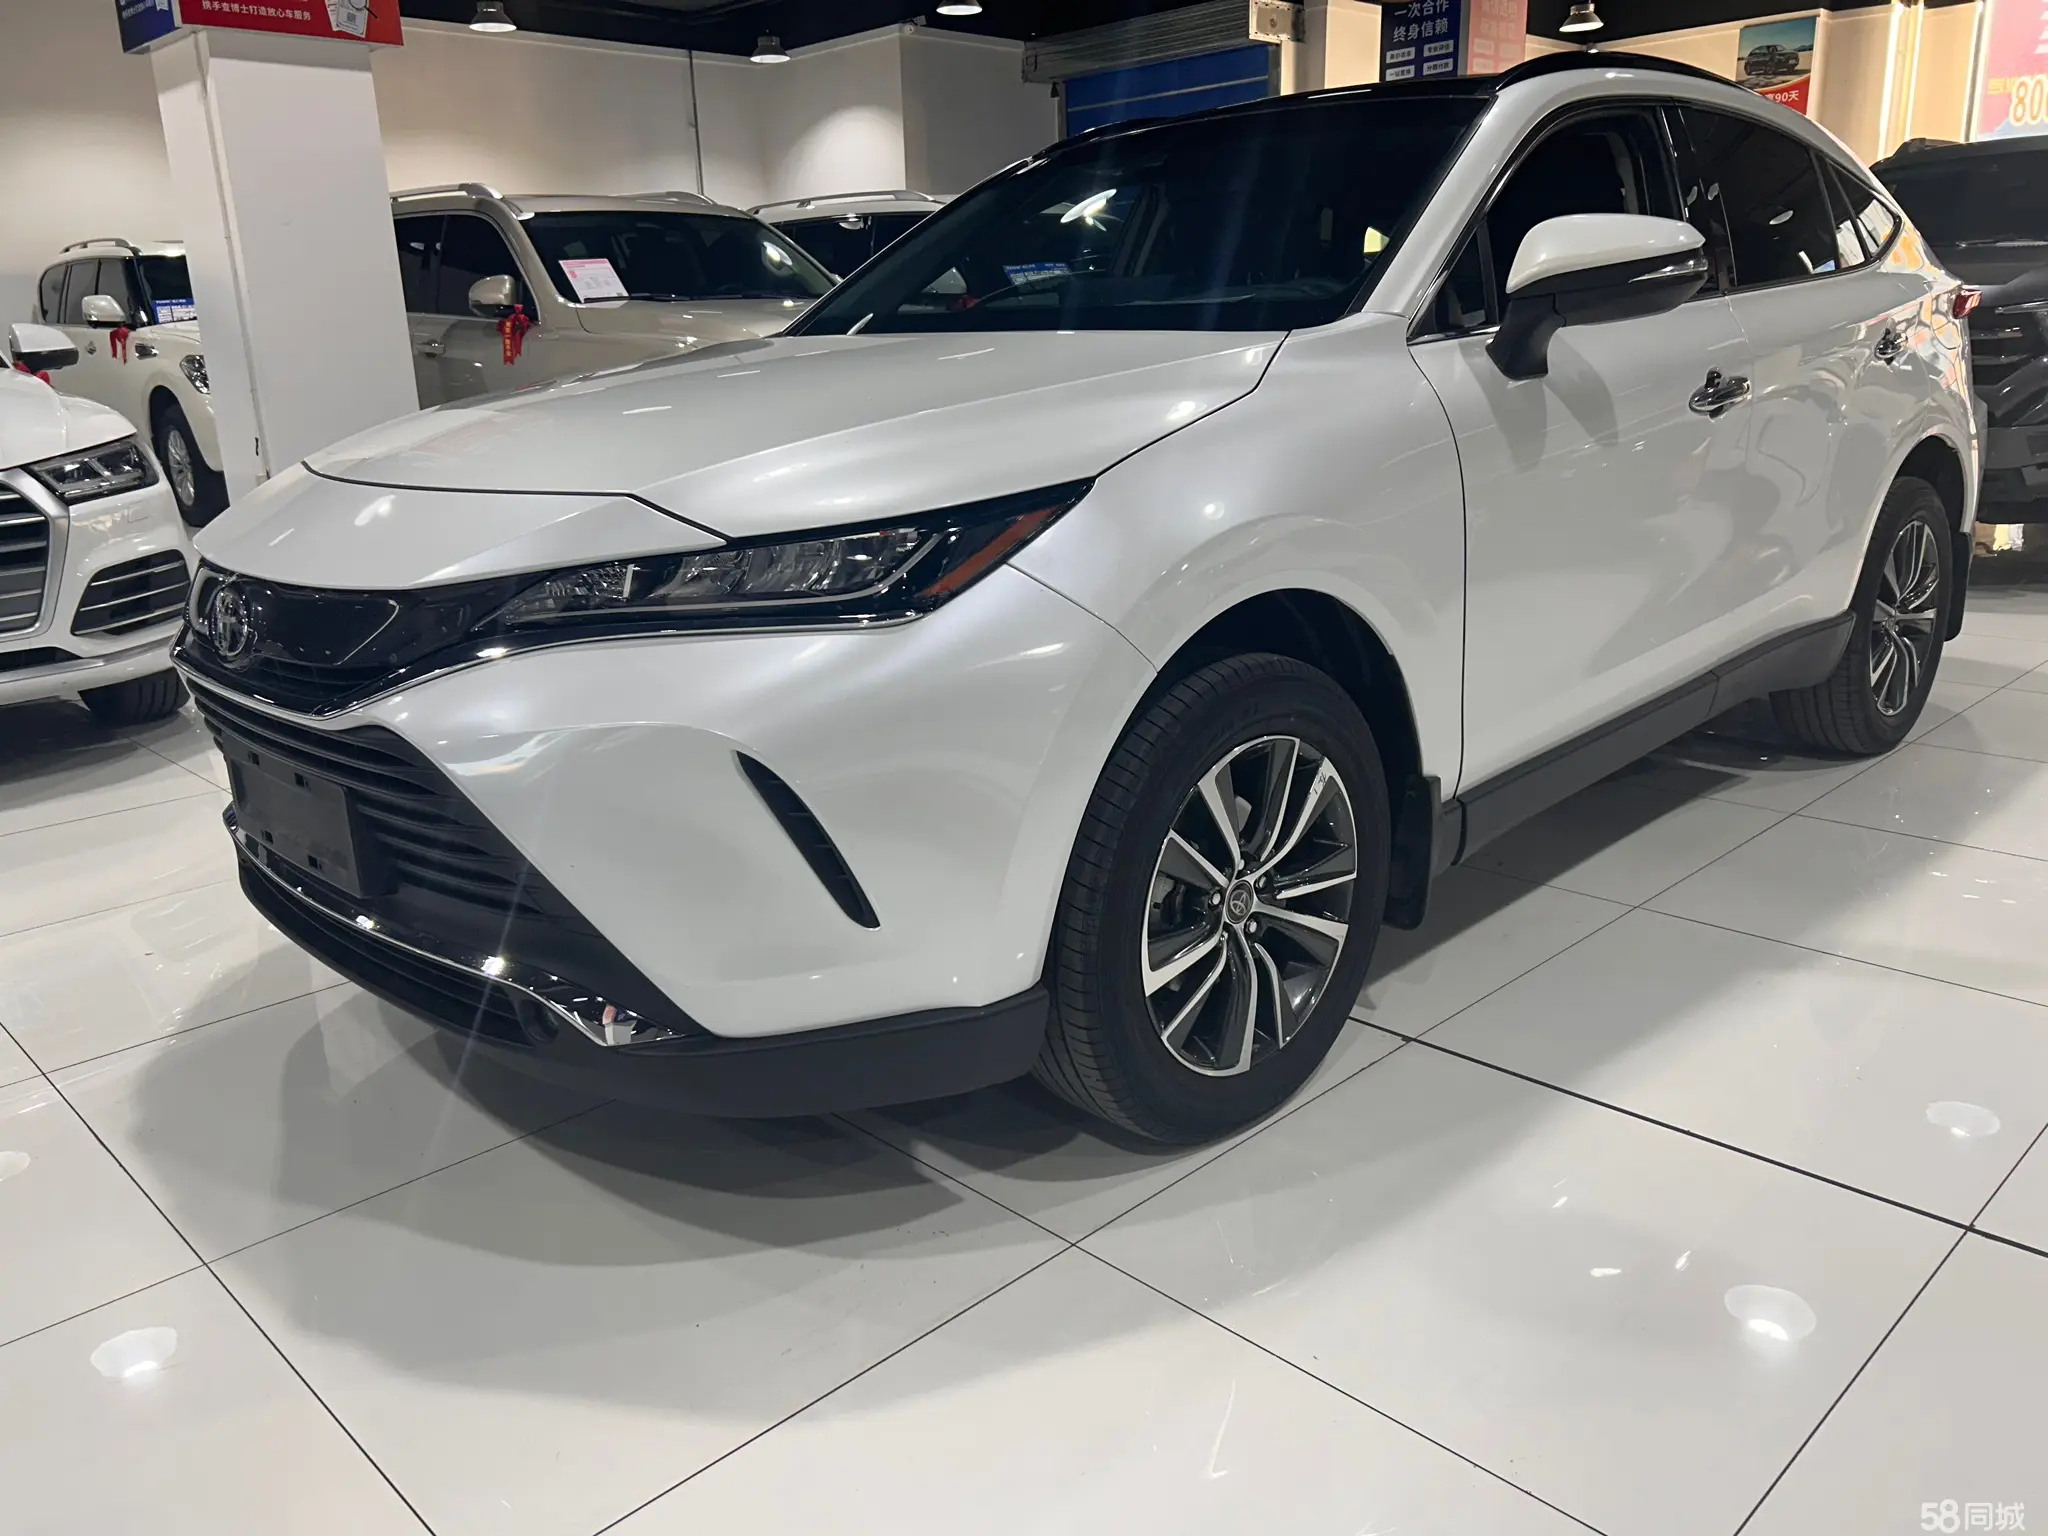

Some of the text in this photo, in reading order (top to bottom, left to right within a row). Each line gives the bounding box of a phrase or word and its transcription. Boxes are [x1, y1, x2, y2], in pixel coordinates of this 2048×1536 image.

[202, 0, 311, 21] 携手查博士打造放心车服务
[1394, 0, 1449, 18] 一次合作
[1393, 17, 1449, 42] 终身信赖
